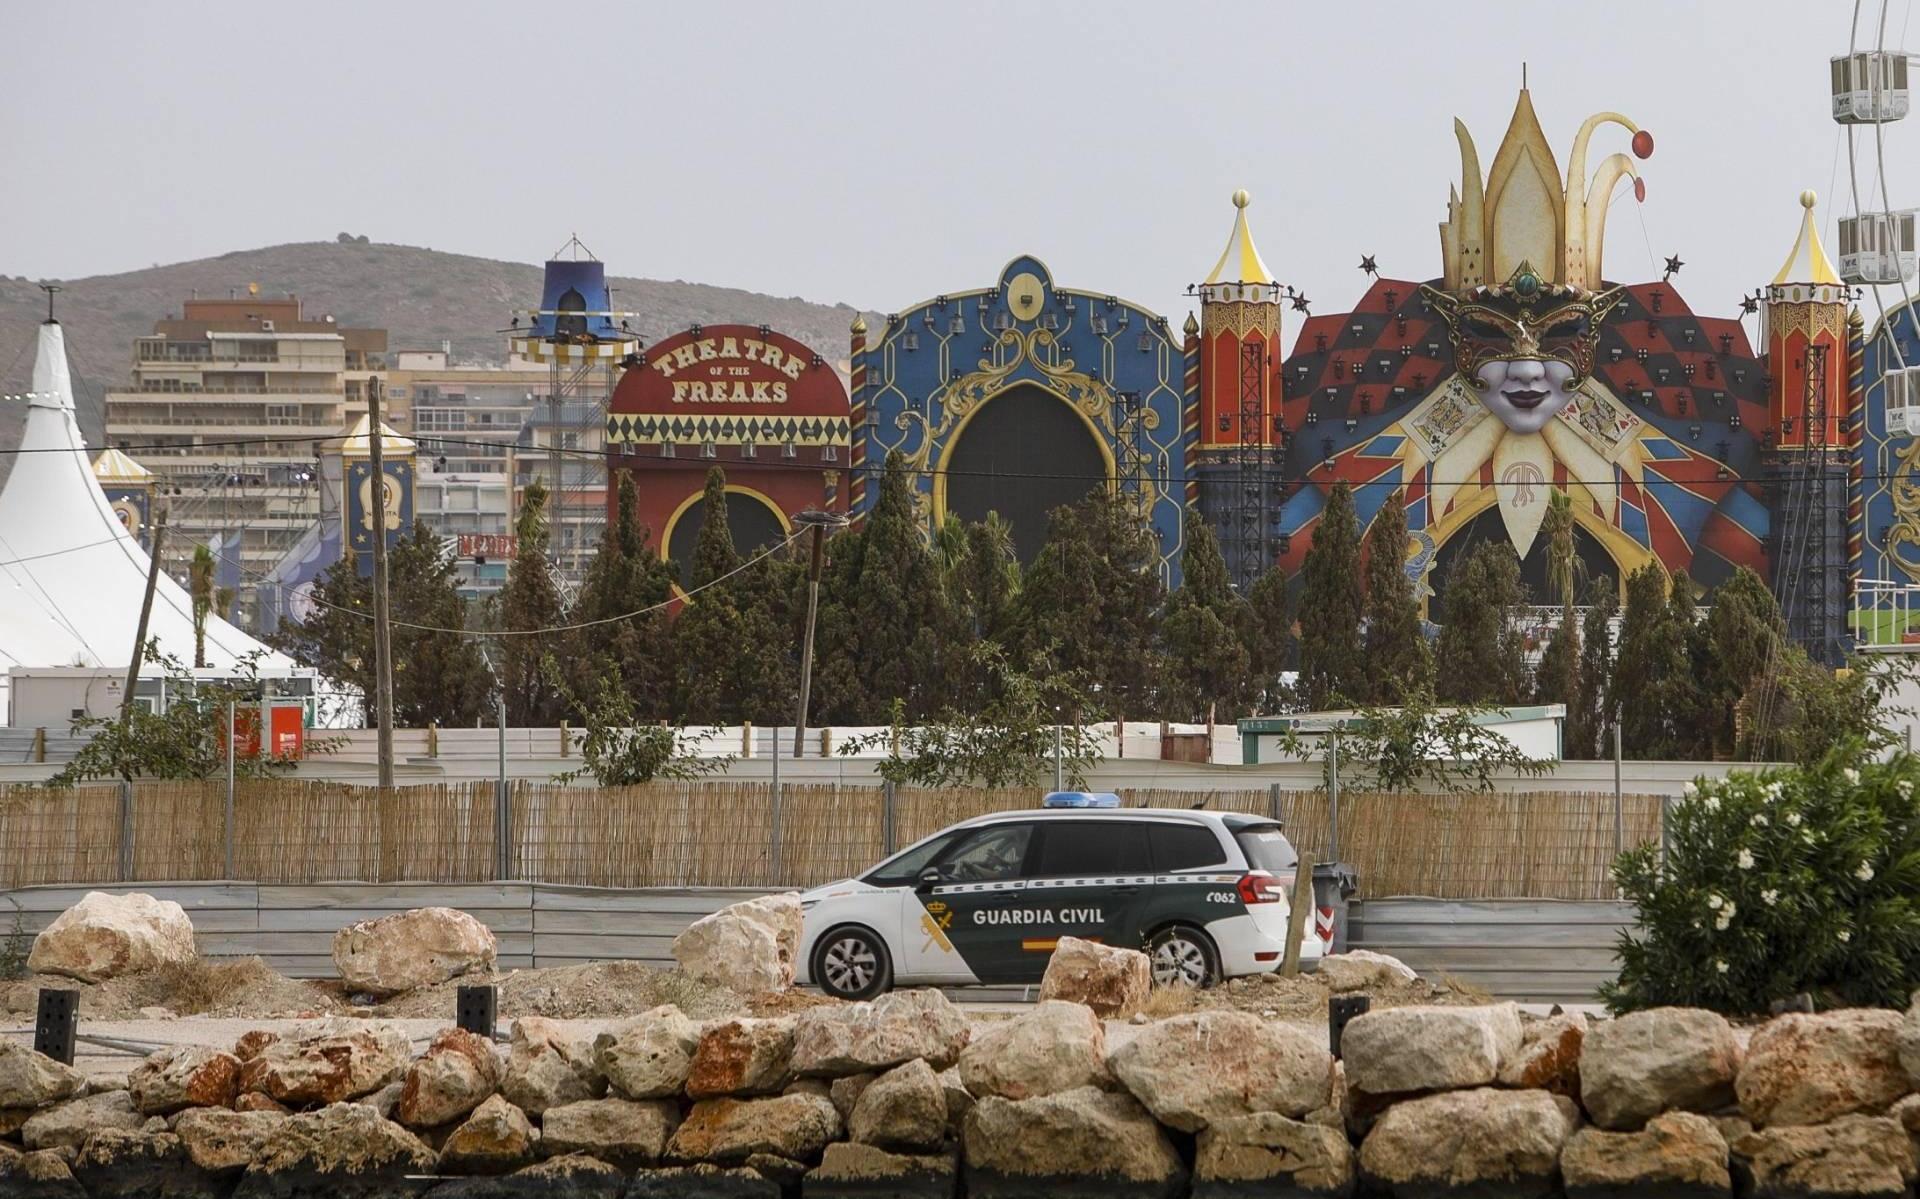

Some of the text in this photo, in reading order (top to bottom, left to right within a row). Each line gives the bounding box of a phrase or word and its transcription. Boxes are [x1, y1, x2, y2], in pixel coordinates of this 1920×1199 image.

[652, 336, 806, 381] THEATRE
[709, 367, 750, 375] OF THE
[672, 380, 788, 403] FREAKS
[1214, 893, 1236, 903] 062
[973, 909, 1105, 924] GUARDIA CIVIL
